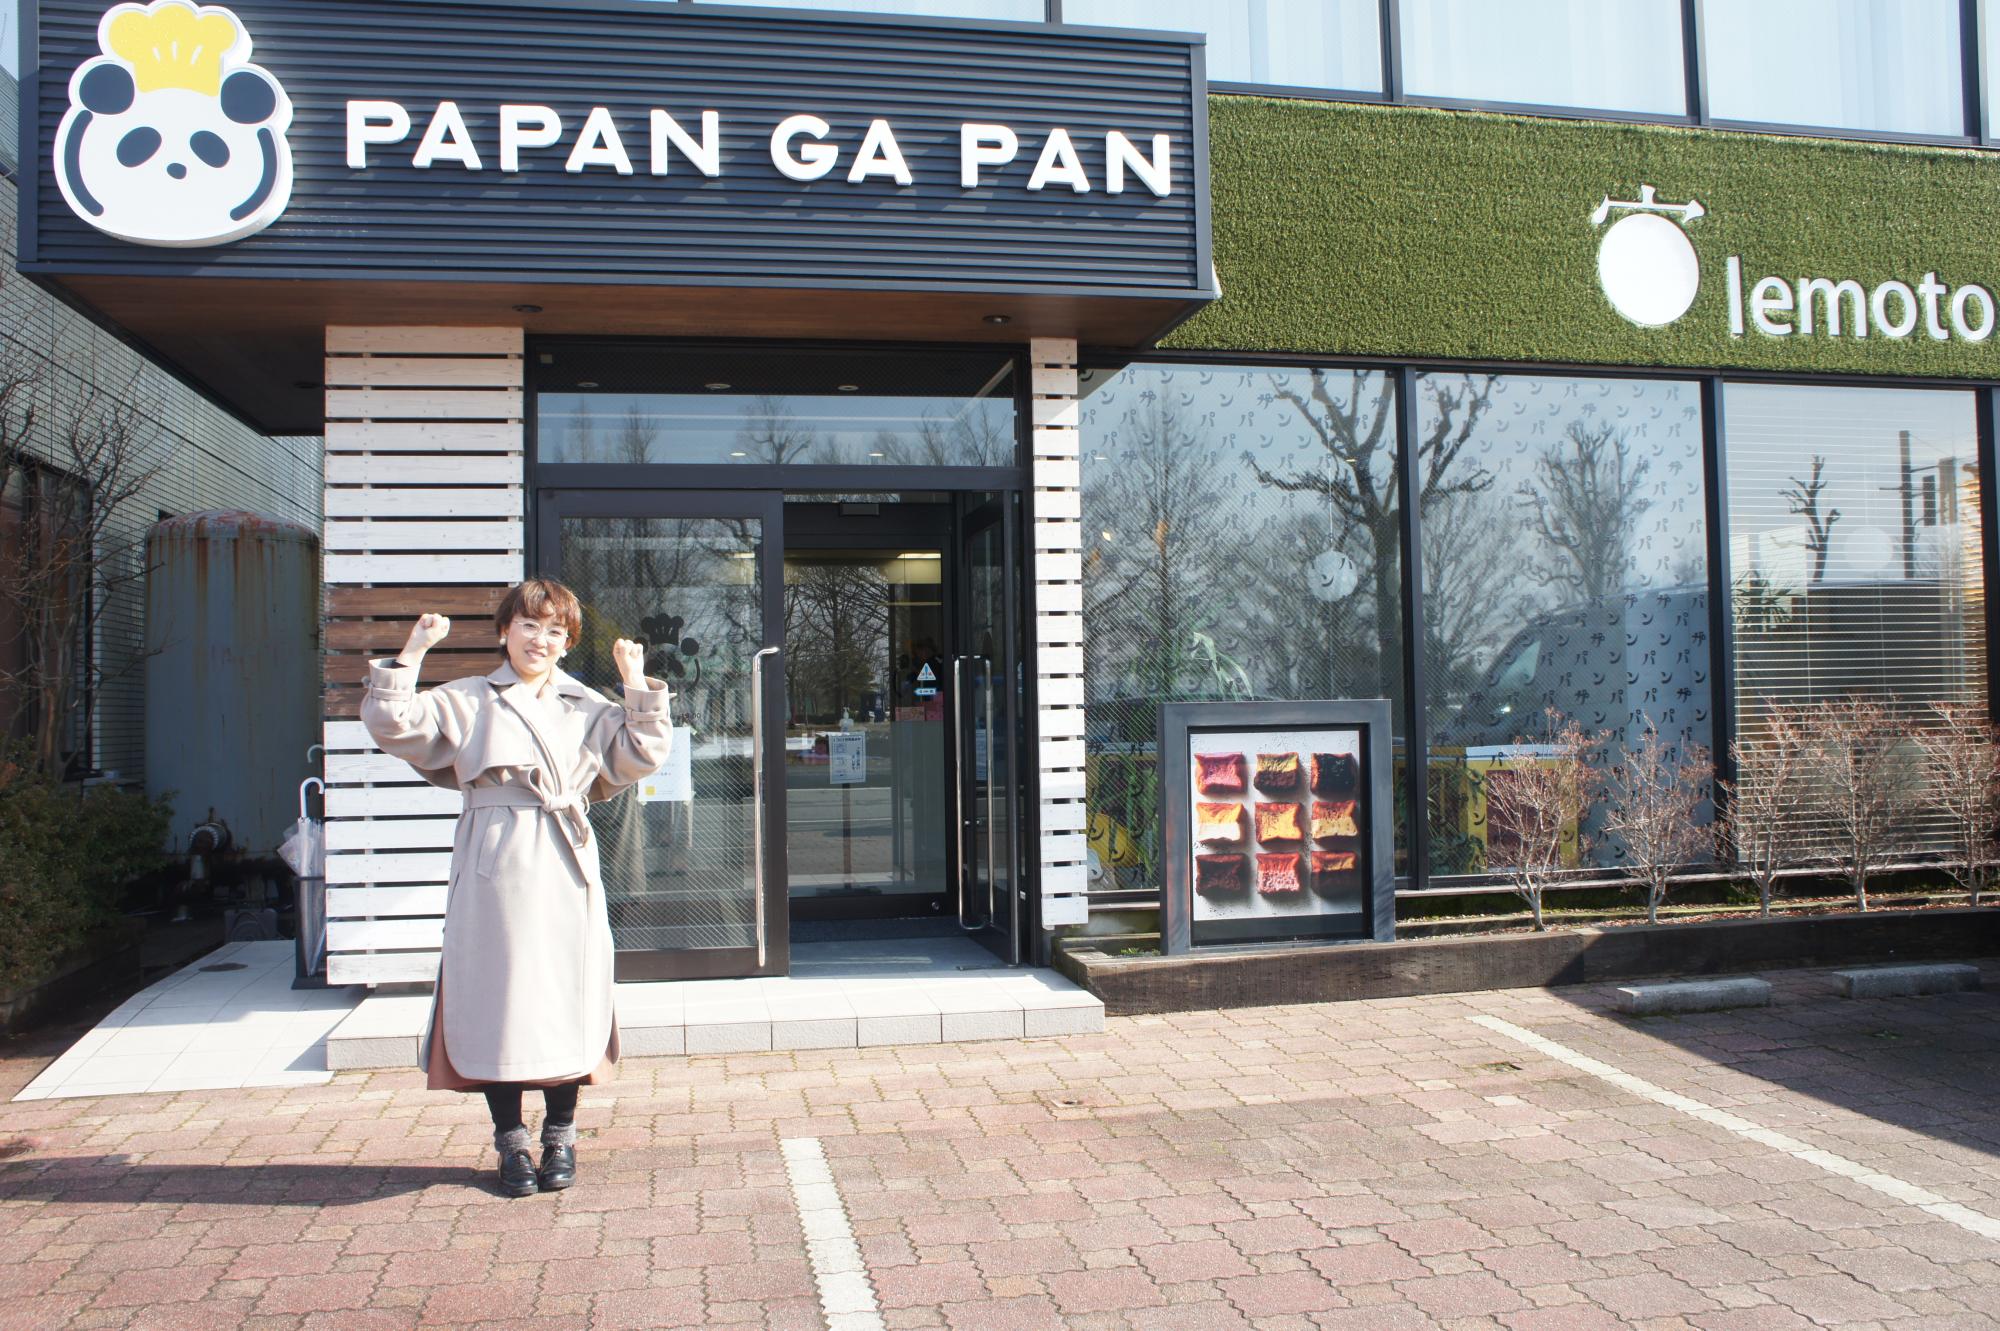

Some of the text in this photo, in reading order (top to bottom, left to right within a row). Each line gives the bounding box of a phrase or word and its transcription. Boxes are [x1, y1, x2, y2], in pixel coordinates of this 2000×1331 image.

[345, 100, 1171, 198] PAPAN GA PAN
[1726, 254, 1995, 342] lemoto
[1119, 369, 1135, 385] パ
[1161, 370, 1175, 384] ン
[1201, 371, 1213, 385] ン
[1238, 372, 1253, 387] パ
[1278, 373, 1289, 387] ン
[1496, 381, 1508, 394] ン
[1530, 382, 1542, 395] ン
[1564, 383, 1578, 398] パ
[1599, 384, 1611, 397] ン
[1633, 384, 1645, 398] ン
[1666, 386, 1679, 400] パ
[1100, 391, 1115, 405] ン
[1181, 392, 1195, 406] ン
[1220, 393, 1234, 407] ン
[1080, 408, 1096, 425] パ
[1120, 408, 1136, 425] パ
[1161, 410, 1175, 425] ン
[1200, 412, 1215, 427] パ
[1239, 412, 1254, 426] パ
[1277, 413, 1291, 426] ン
[1514, 402, 1527, 415] ン
[1549, 403, 1561, 416] ン
[1616, 405, 1629, 418] ン
[1650, 406, 1662, 419] ン
[1497, 420, 1509, 432] ン
[1531, 420, 1545, 435] パ
[1634, 423, 1647, 438] パ
[1668, 423, 1681, 438] パ
[1101, 431, 1117, 447] パ
[1182, 433, 1196, 447] ン
[1221, 433, 1236, 448] パ
[1259, 434, 1274, 448] ン
[1298, 434, 1311, 449] ン
[1481, 440, 1492, 452] ン
[1516, 440, 1528, 453] ン
[1652, 444, 1664, 456] ン
[1686, 445, 1698, 457] ン
[1081, 449, 1097, 465] パ
[1201, 451, 1216, 467] パ
[1279, 453, 1294, 469] パ
[1317, 454, 1331, 468] パ
[1498, 458, 1512, 472] パ
[1603, 460, 1615, 474] パ
[1103, 472, 1119, 486] パ
[1221, 473, 1237, 488] パ
[1654, 481, 1666, 495] パ
[1687, 482, 1698, 495] ン
[1242, 492, 1295, 508] パ パ
[1501, 496, 1684, 512] パ パ
[1221, 513, 1238, 529] パ
[1654, 518, 1668, 532] パ
[1688, 519, 1702, 534] パ
[1639, 536, 1685, 550] パ ン
[1656, 556, 1670, 570] パ
[1321, 574, 1334, 587] ン
[1640, 574, 1652, 586] ン
[1692, 594, 1704, 608] パ
[1608, 612, 1688, 626] ン ン パ
[1626, 634, 1638, 646] ン
[1660, 633, 1671, 646] ン
[1575, 650, 1588, 665] パ
[1609, 651, 1621, 664] ン
[1642, 650, 1656, 665] パ
[1676, 649, 1690, 664] パ
[1593, 672, 1605, 685] ン
[1627, 672, 1639, 685] ン
[1661, 672, 1672, 684] ン
[1694, 670, 1706, 684] ン
[1610, 689, 1624, 704] パ
[1644, 688, 1657, 703] パ
[1594, 711, 1606, 724] ン
[1628, 709, 1642, 725] パ
[1661, 708, 1675, 724] パ
[1696, 709, 1707, 722] ン
[1612, 726, 1625, 742] パ
[1489, 752, 1503, 767] パ
[1662, 747, 1676, 762] パ
[1474, 812, 1485, 825] ン
[1090, 826, 1104, 841] ン
[1112, 847, 1125, 862] ン
